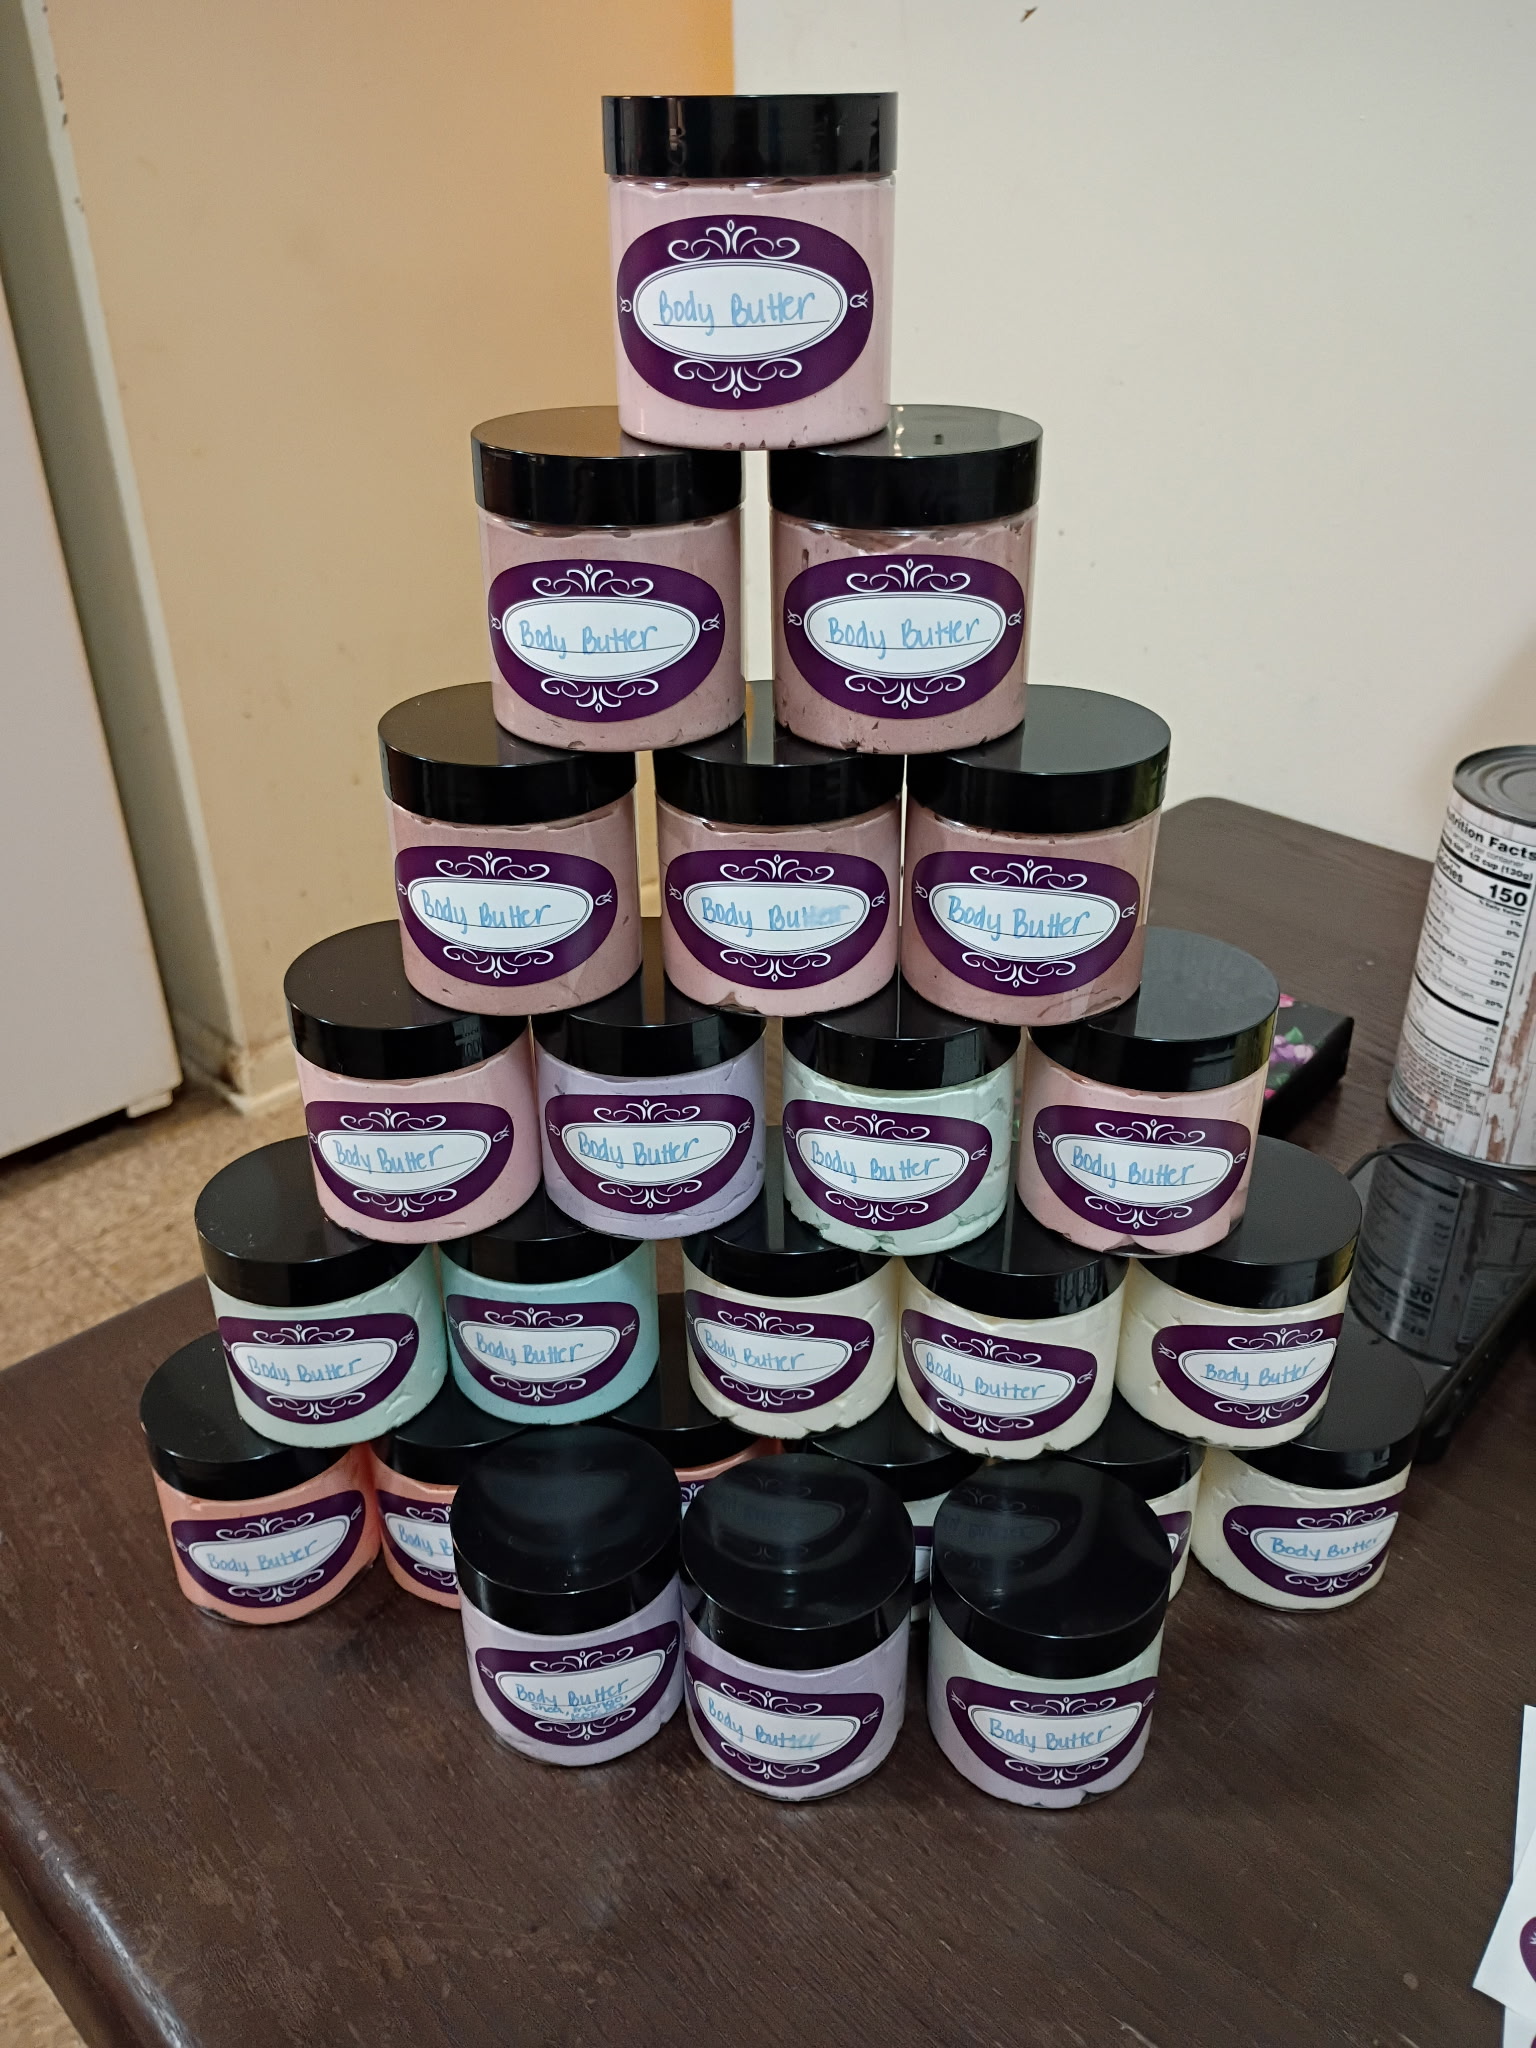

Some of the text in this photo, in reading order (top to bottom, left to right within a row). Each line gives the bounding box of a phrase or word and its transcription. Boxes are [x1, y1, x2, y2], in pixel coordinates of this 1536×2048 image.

[659, 290, 816, 335] Body Butter
[519, 619, 658, 660] Body Butter
[827, 617, 981, 660] Body Butter
[1470, 851, 1481, 862] 1/2
[1482, 859, 1499, 871] cup
[1501, 864, 1533, 882] (130g)
[1489, 836, 1536, 862] Facts
[421, 889, 553, 935] Body Butter
[1489, 884, 1528, 907] 150
[700, 896, 754, 938] Body
[947, 895, 1091, 942] Body Butter
[333, 1139, 445, 1174] Body Butter
[578, 1132, 700, 1169] Body Butter
[811, 1140, 941, 1184] Body Butter
[1071, 1146, 1195, 1189] Body Butter
[476, 1332, 585, 1367] Body Butter
[703, 1328, 737, 1369] Body
[247, 1354, 363, 1386] Body Butter
[925, 1351, 1046, 1401] Body Butter
[1205, 1357, 1316, 1390] Body Butter
[398, 1523, 434, 1557] Body
[1270, 1530, 1385, 1562] Body Butter
[206, 1540, 318, 1578] Body Butter
[515, 1678, 629, 1709] Body Butter
[707, 1696, 744, 1743] Body
[988, 1716, 1114, 1753] Body Butter
